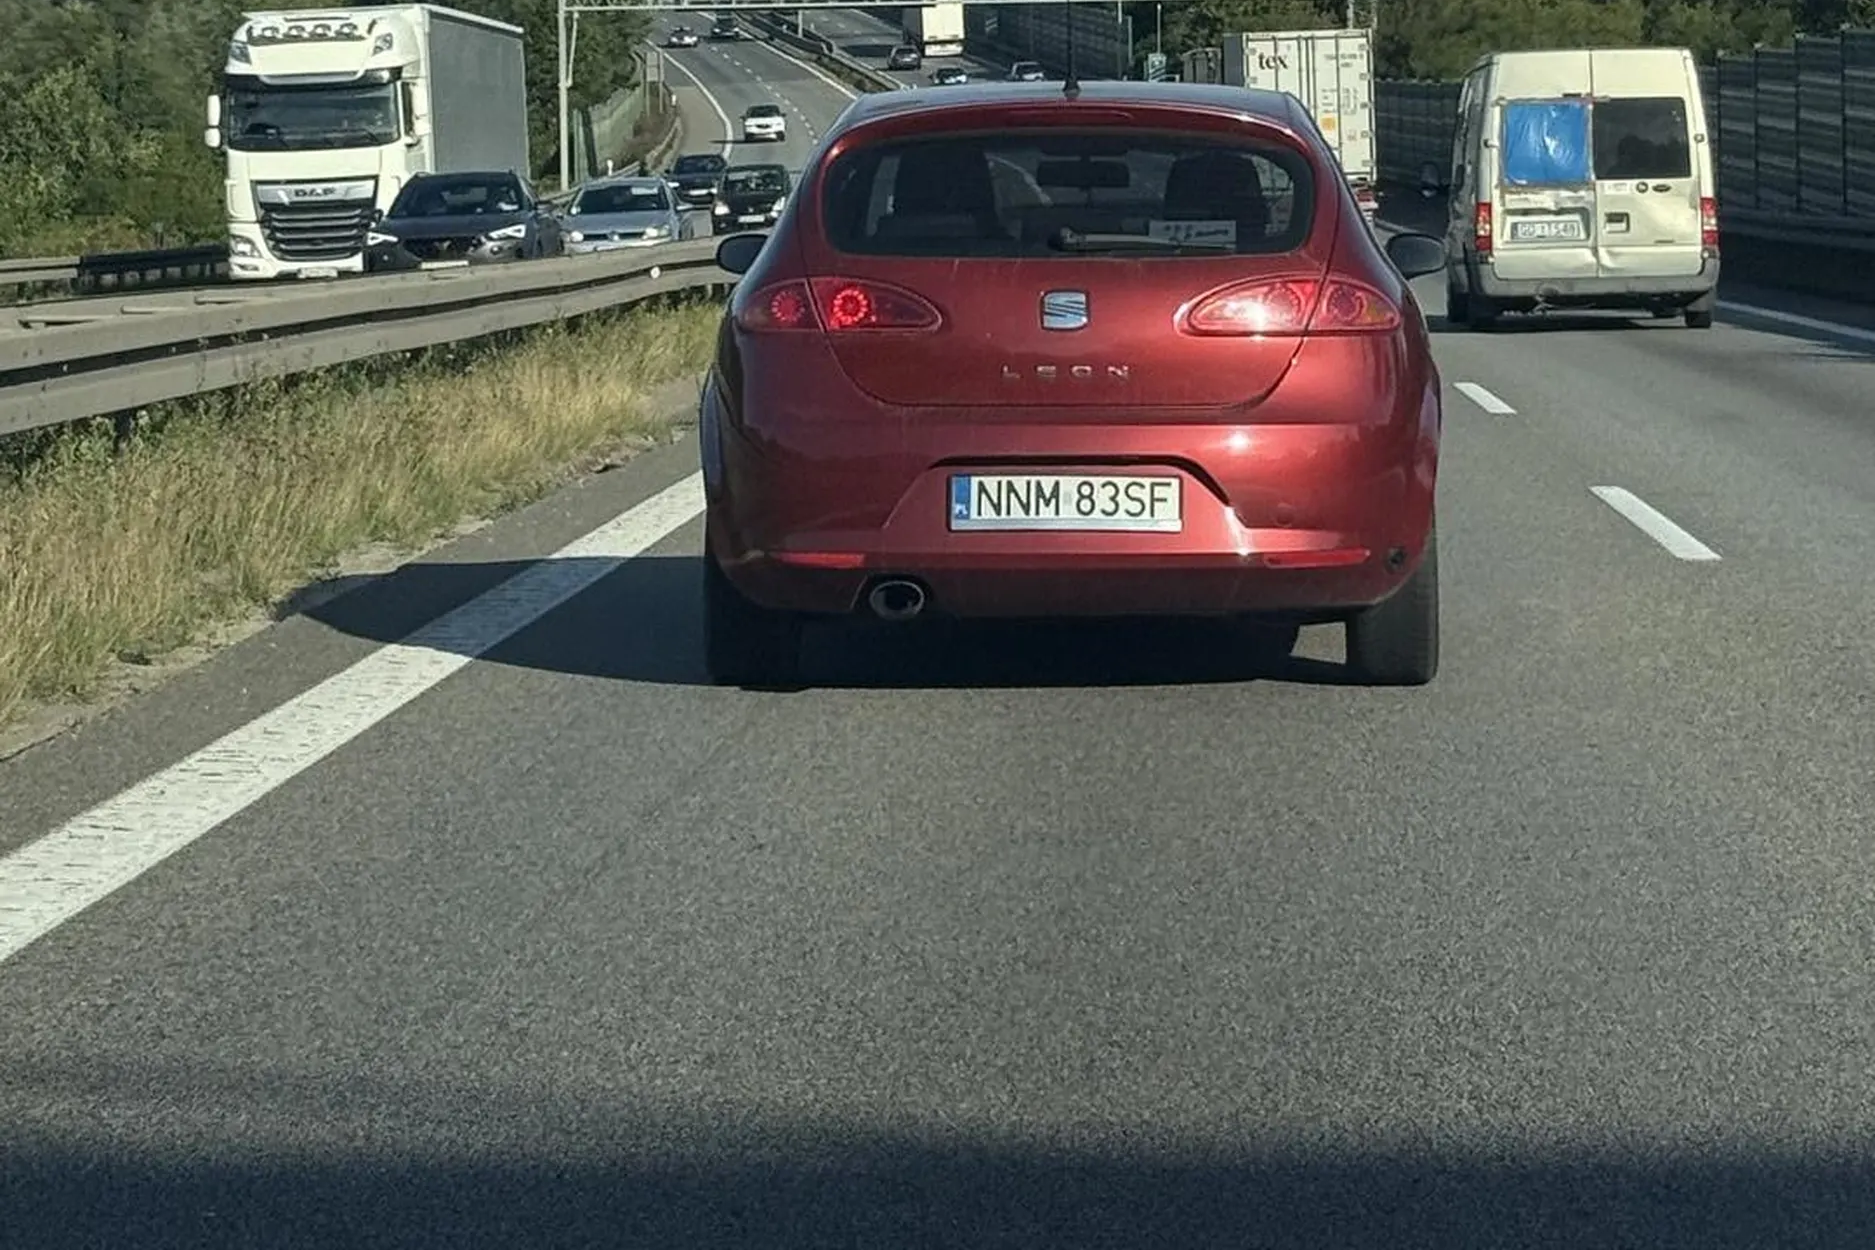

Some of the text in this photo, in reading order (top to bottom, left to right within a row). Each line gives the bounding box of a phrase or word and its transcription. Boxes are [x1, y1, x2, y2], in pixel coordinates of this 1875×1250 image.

[1003, 365, 1129, 379] LEON
[977, 480, 1172, 518] NNM 83SF
